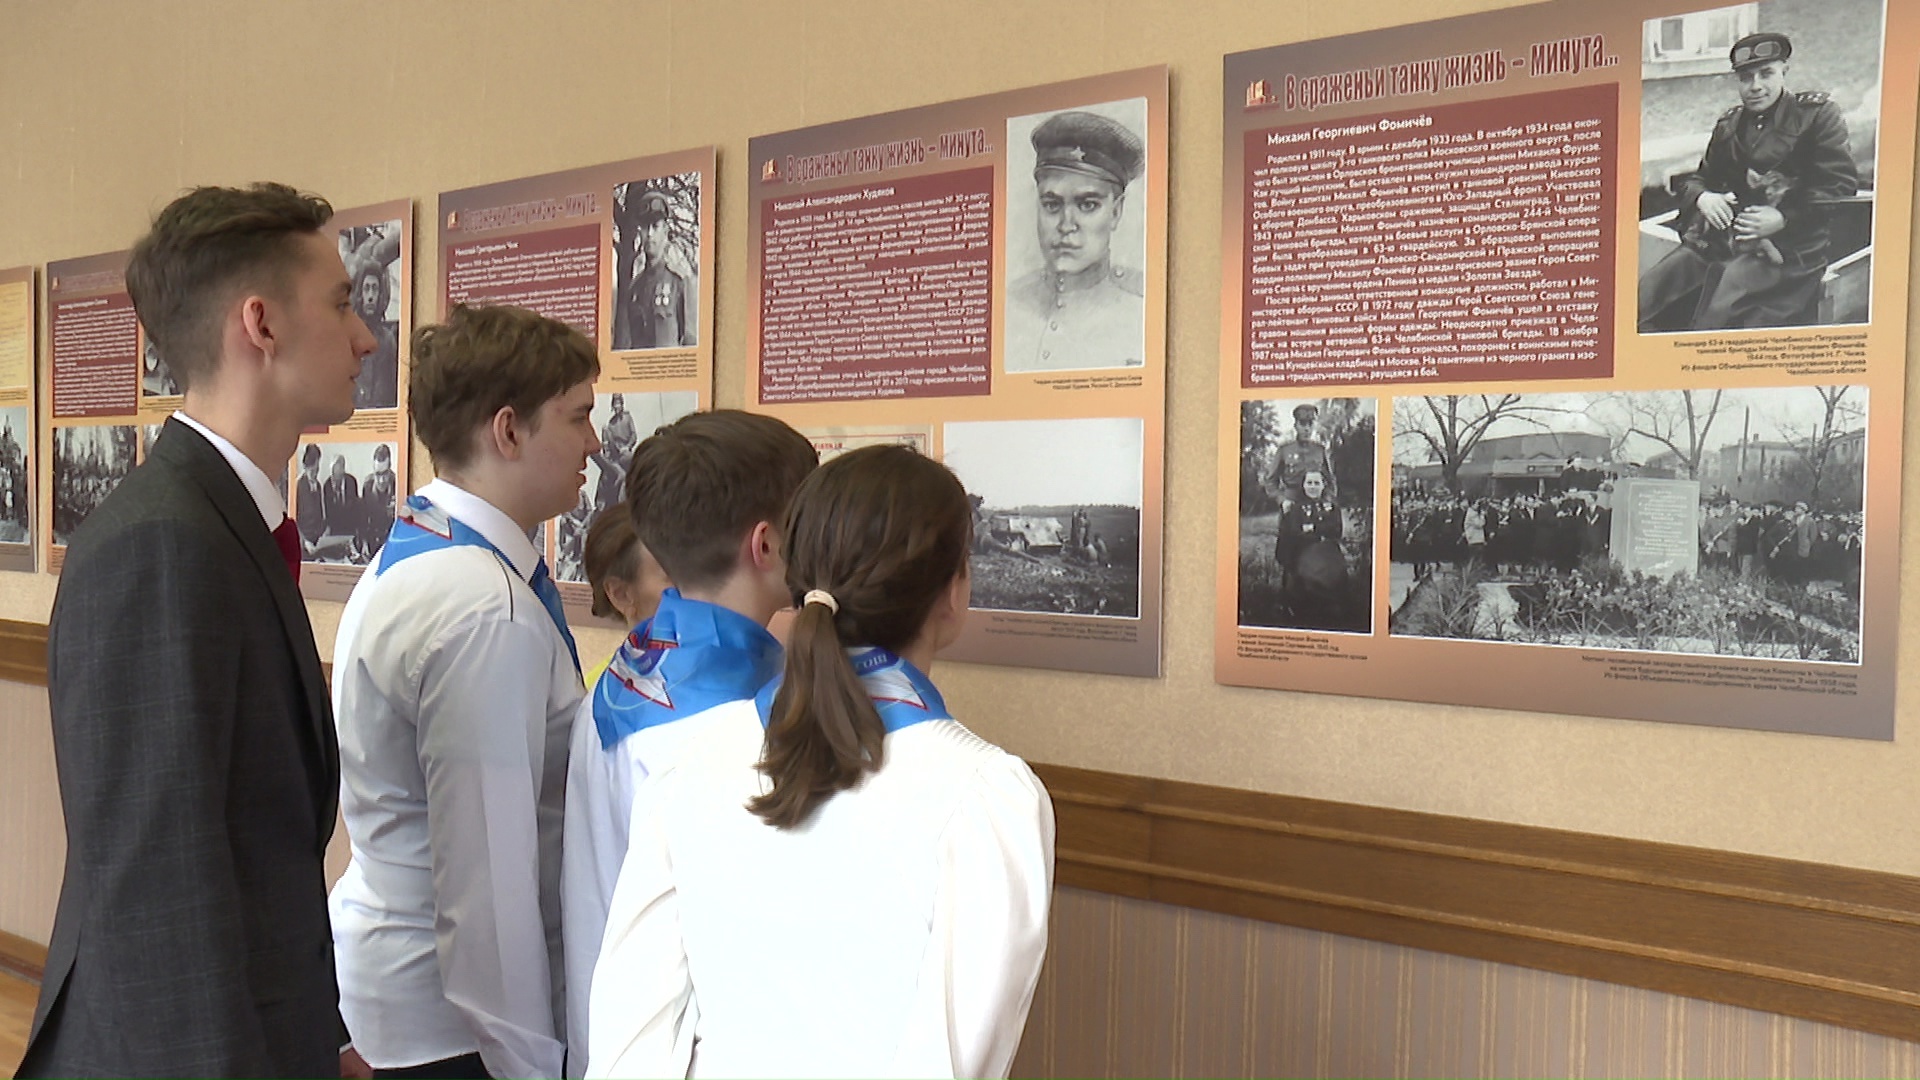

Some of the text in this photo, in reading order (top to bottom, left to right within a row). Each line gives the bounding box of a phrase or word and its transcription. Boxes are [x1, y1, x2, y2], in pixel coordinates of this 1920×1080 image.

[1285, 75, 1295, 110] В
[1300, 67, 1385, 110] сраженьи
[1390, 60, 1440, 95] танку
[1445, 51, 1506, 87] жизнь
[1530, 35, 1619, 77] минута...
[1267, 114, 1432, 145] Михаил Георгиевич Фомичёв
[1429, 133, 1450, 145] 1933
[1485, 126, 1523, 138] октябре
[1525, 122, 1548, 133] 1934
[1549, 121, 1572, 131] года
[1429, 143, 1488, 156] Московского
[1490, 137, 1534, 149] военного
[1572, 130, 1601, 140] после
[786, 155, 794, 182] В
[797, 154, 850, 185] сраженьи
[853, 144, 884, 173] танку
[886, 138, 925, 167] жизнь
[1444, 155, 1485, 168] училище
[1486, 151, 1516, 162] имени
[1517, 146, 1561, 158] Михаила
[1434, 168, 1468, 180] служил
[1528, 158, 1562, 169] взвода
[1410, 182, 1450, 193] встретил
[1461, 174, 1504, 188] танковой
[1507, 172, 1547, 184] дивизии
[1549, 166, 1601, 179] Киевского
[1442, 179, 1601, 201] Юго-Западный Участвовал
[1448, 201, 1491, 212] защищал
[1564, 191, 1600, 202] августа
[1461, 211, 1520, 223] командиром
[1522, 206, 1551, 218] 244-й
[1429, 227, 1463, 238] заслуги
[1472, 217, 1565, 235] Орловско-Брянской
[1463, 237, 1476, 246] За
[1480, 233, 1535, 246] образцовое
[1540, 228, 1600, 240] выполнение
[1496, 242, 1545, 257] Пражской
[1547, 240, 1599, 252] операциях
[1417, 263, 1454, 274] дважды
[1454, 260, 1503, 272] присвоено
[1537, 255, 1565, 266] Героя
[1420, 285, 1471, 295] командные
[1529, 278, 1568, 291] работал
[1425, 274, 1459, 284] медали
[1460, 271, 1502, 281] «Золотая
[1416, 298, 1453, 308] дважды
[1454, 294, 1482, 306] Герой
[1483, 293, 1537, 303] Советского
[1539, 291, 1570, 300] Союза
[1417, 309, 1468, 320] Георгиевич
[1471, 305, 1514, 316] Фомичёв
[1517, 305, 1543, 315] ушел
[1555, 302, 1599, 311] отставку
[1440, 319, 1507, 329] Неоднократно
[1455, 329, 1498, 340] танковой
[1548, 326, 1559, 336] 18
[1562, 325, 1598, 336] ноября
[1460, 342, 1509, 352] похоронен
[1517, 340, 1569, 349] воинскими
[1422, 355, 1436, 364] На
[1436, 355, 1485, 364] памятнике
[1498, 353, 1536, 363] черного
[1537, 352, 1575, 362] гранита
